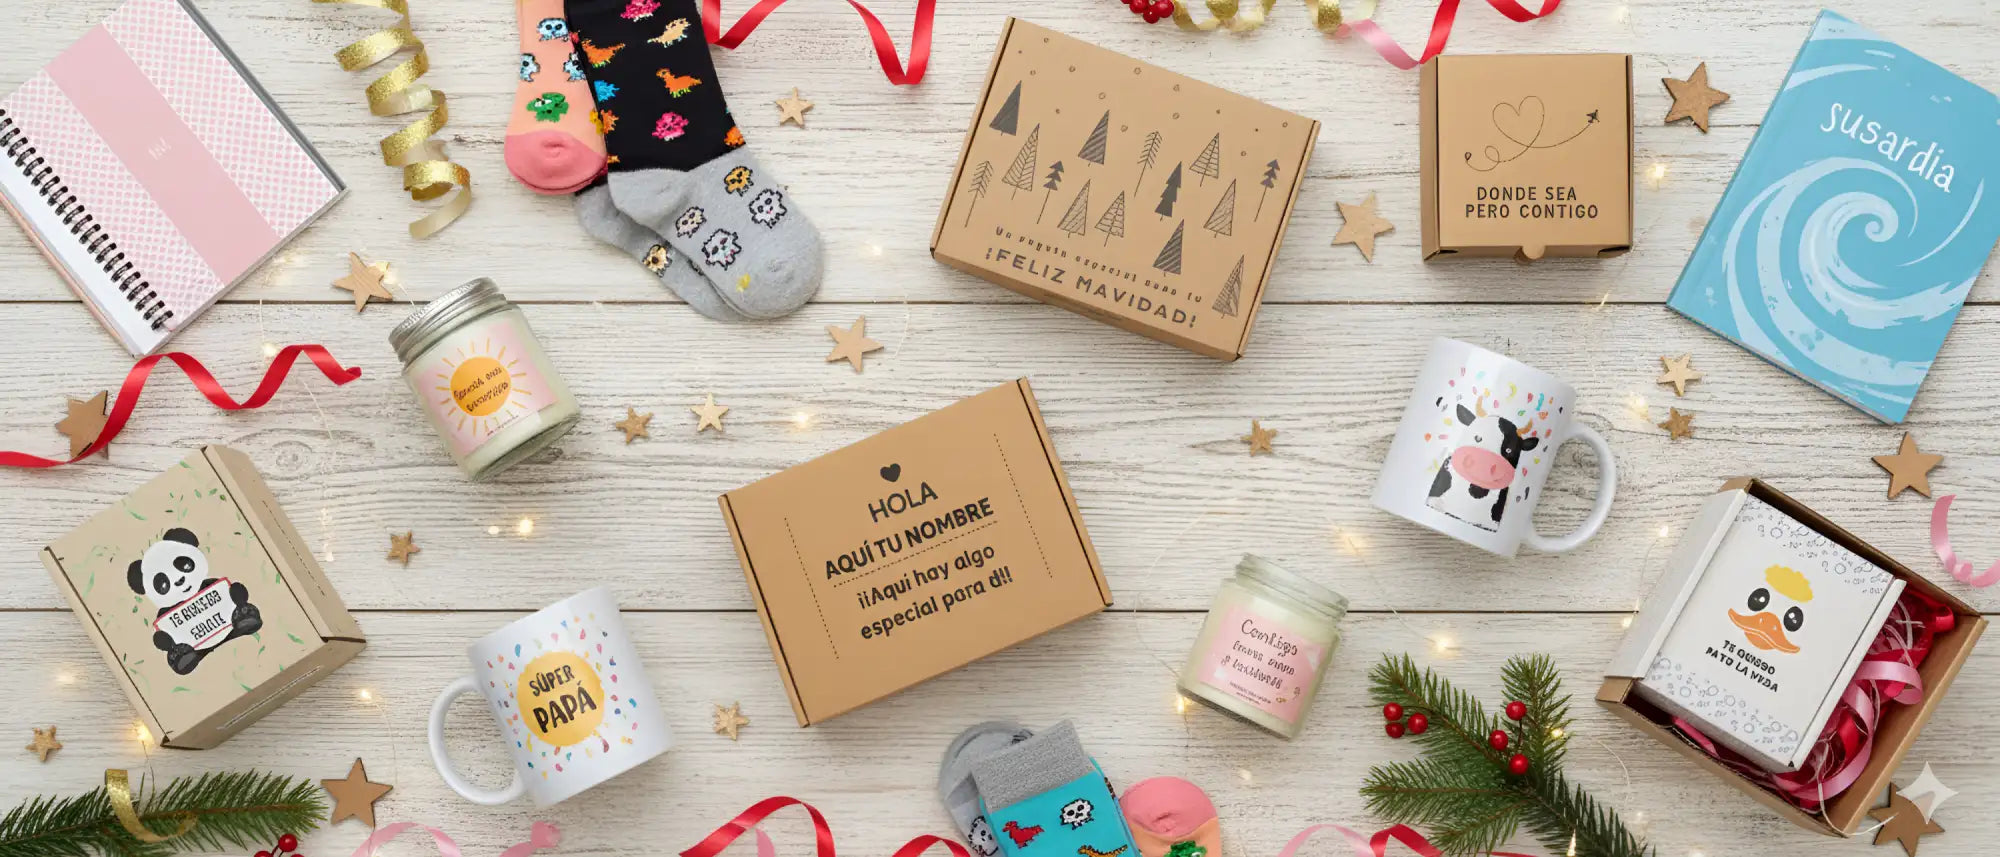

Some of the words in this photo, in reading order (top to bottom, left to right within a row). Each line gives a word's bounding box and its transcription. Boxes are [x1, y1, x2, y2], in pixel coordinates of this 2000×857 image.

[1820, 103, 1954, 193] susardia
[1465, 204, 1510, 218] PERO
[1519, 204, 1598, 218] CONTIGO
[1477, 187, 1536, 201] DONDE
[1545, 187, 1577, 201] SEA
[868, 481, 938, 523] HOLA
[825, 540, 875, 580] AQUÍ
[874, 533, 903, 558] TU
[904, 497, 994, 547] NOMBRE
[954, 546, 995, 570] algo
[861, 596, 939, 640] especial
[1736, 661, 1748, 676] LA
[533, 680, 597, 733] PAPÁ
